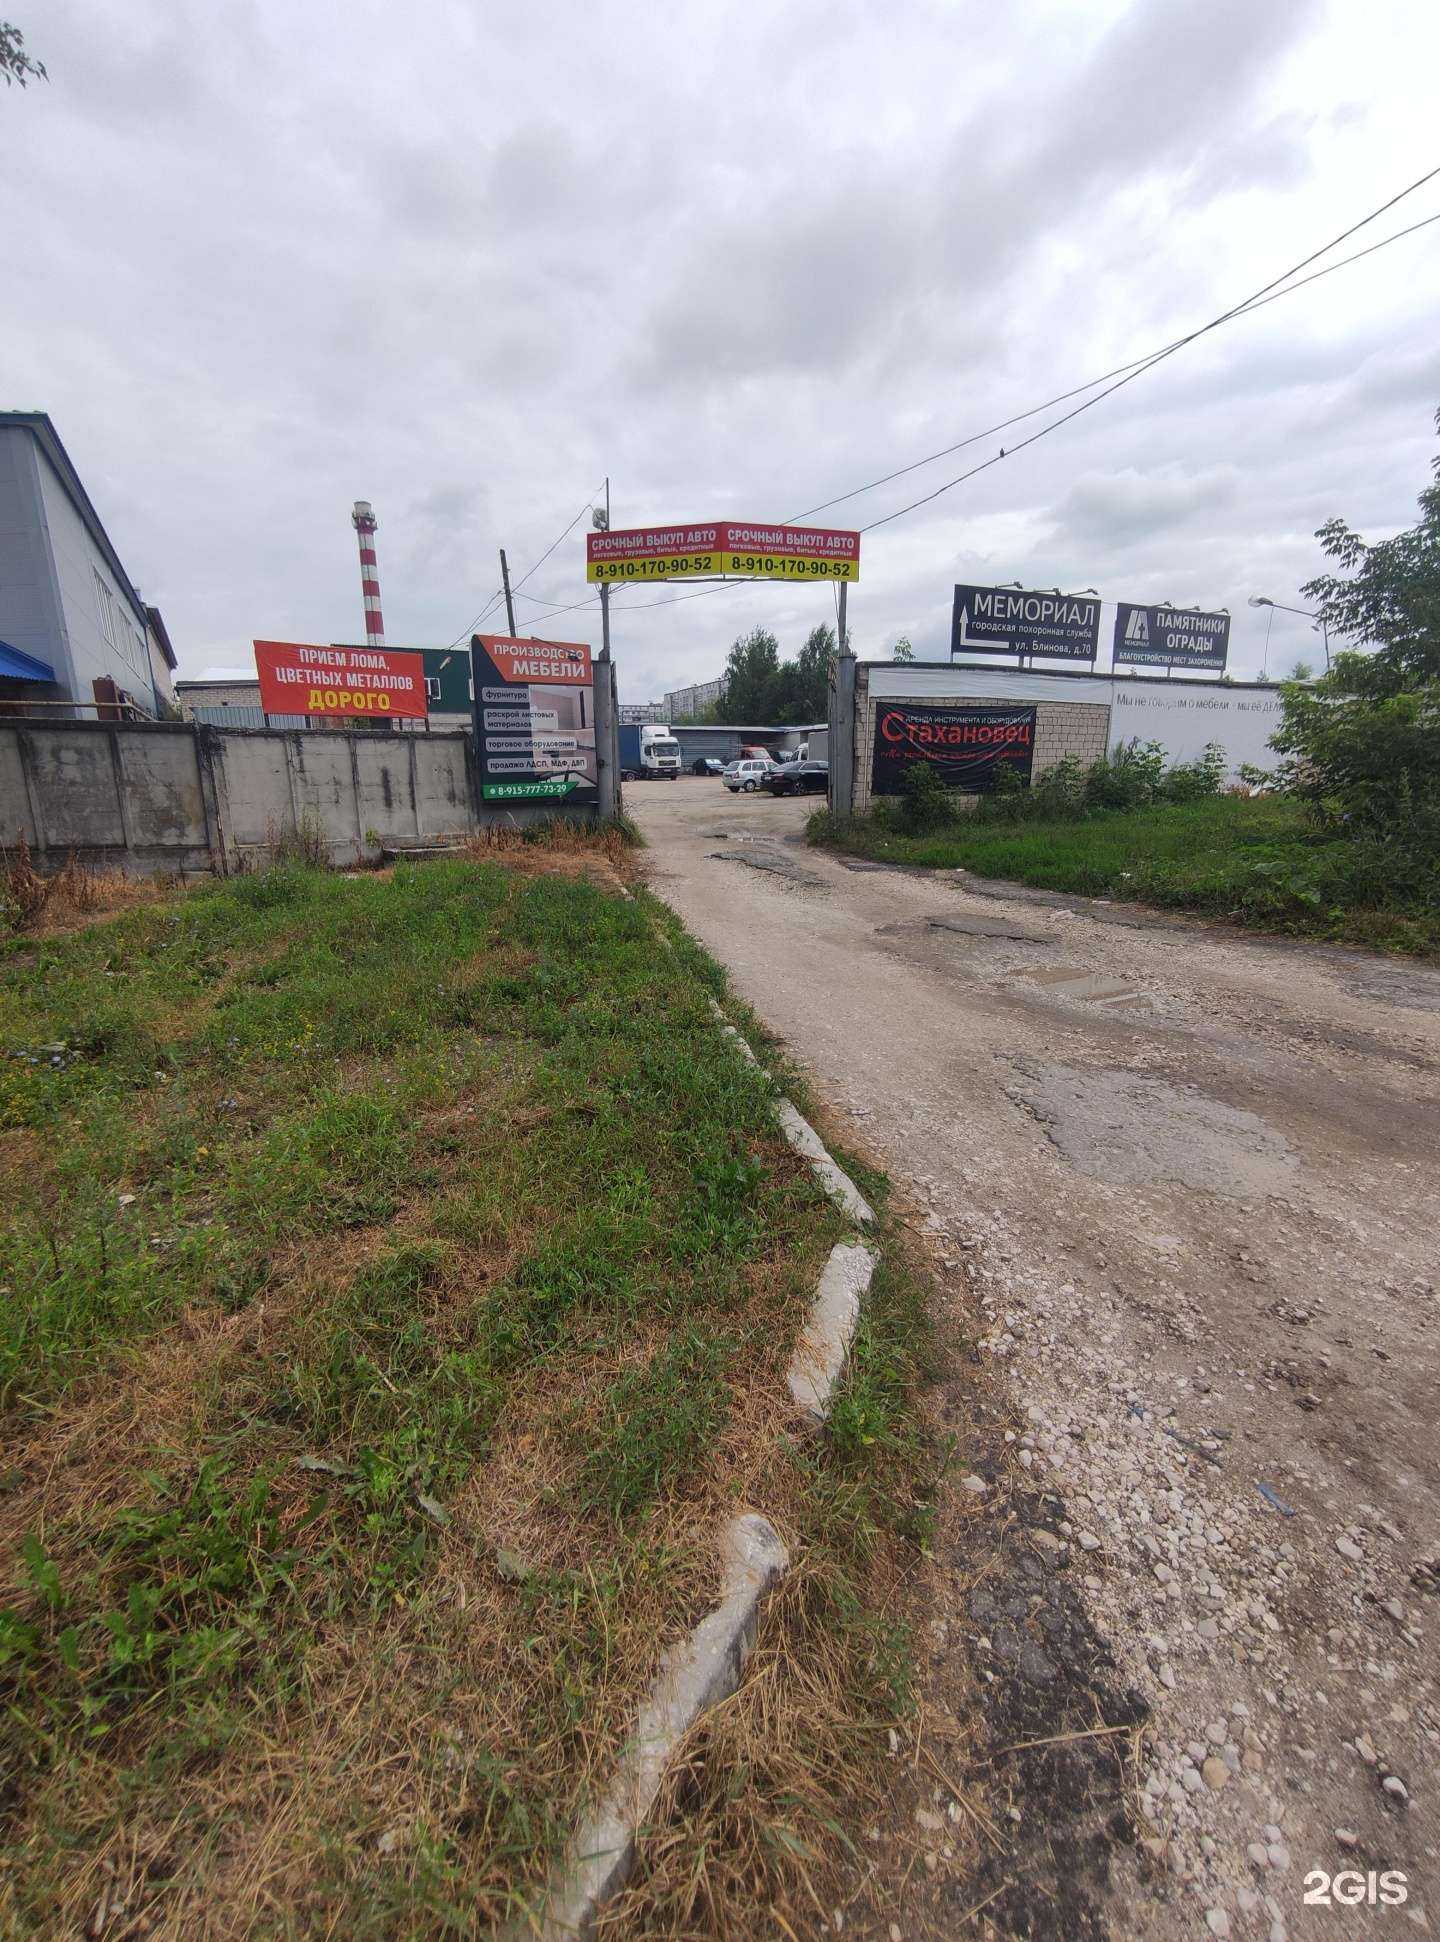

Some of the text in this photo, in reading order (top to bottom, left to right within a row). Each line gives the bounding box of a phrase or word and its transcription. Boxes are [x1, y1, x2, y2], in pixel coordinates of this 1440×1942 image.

[592, 529, 717, 551] СРОЧНЫЙ ВЫКУП АВТО
[727, 528, 855, 549] СРОЧНЫЙ ВЫКУП АВТО
[595, 556, 712, 578] 8-910-170-90-52
[731, 556, 850, 577] 8-910-170-90-52
[973, 593, 1095, 626] МЕМОРИАЛ
[971, 620, 1093, 640] городская похоронная служба
[1156, 612, 1226, 635] ПАМЯТНИКИ
[1014, 640, 1092, 656] ул. Блинова, д.70
[1166, 633, 1214, 654] ОГРАДЫ
[299, 648, 347, 668] ПРИЕМ
[275, 666, 414, 691] ЦВЕТНЫХ МЕТАЛЛОВ
[512, 660, 586, 678] МЕБЕЛИ
[307, 688, 392, 712] ДОРОГО
[881, 711, 1031, 745] Стахановец
[933, 717, 981, 725] ИНСТРУМЕНТА
[497, 784, 568, 796] 8-915-777-73-29
